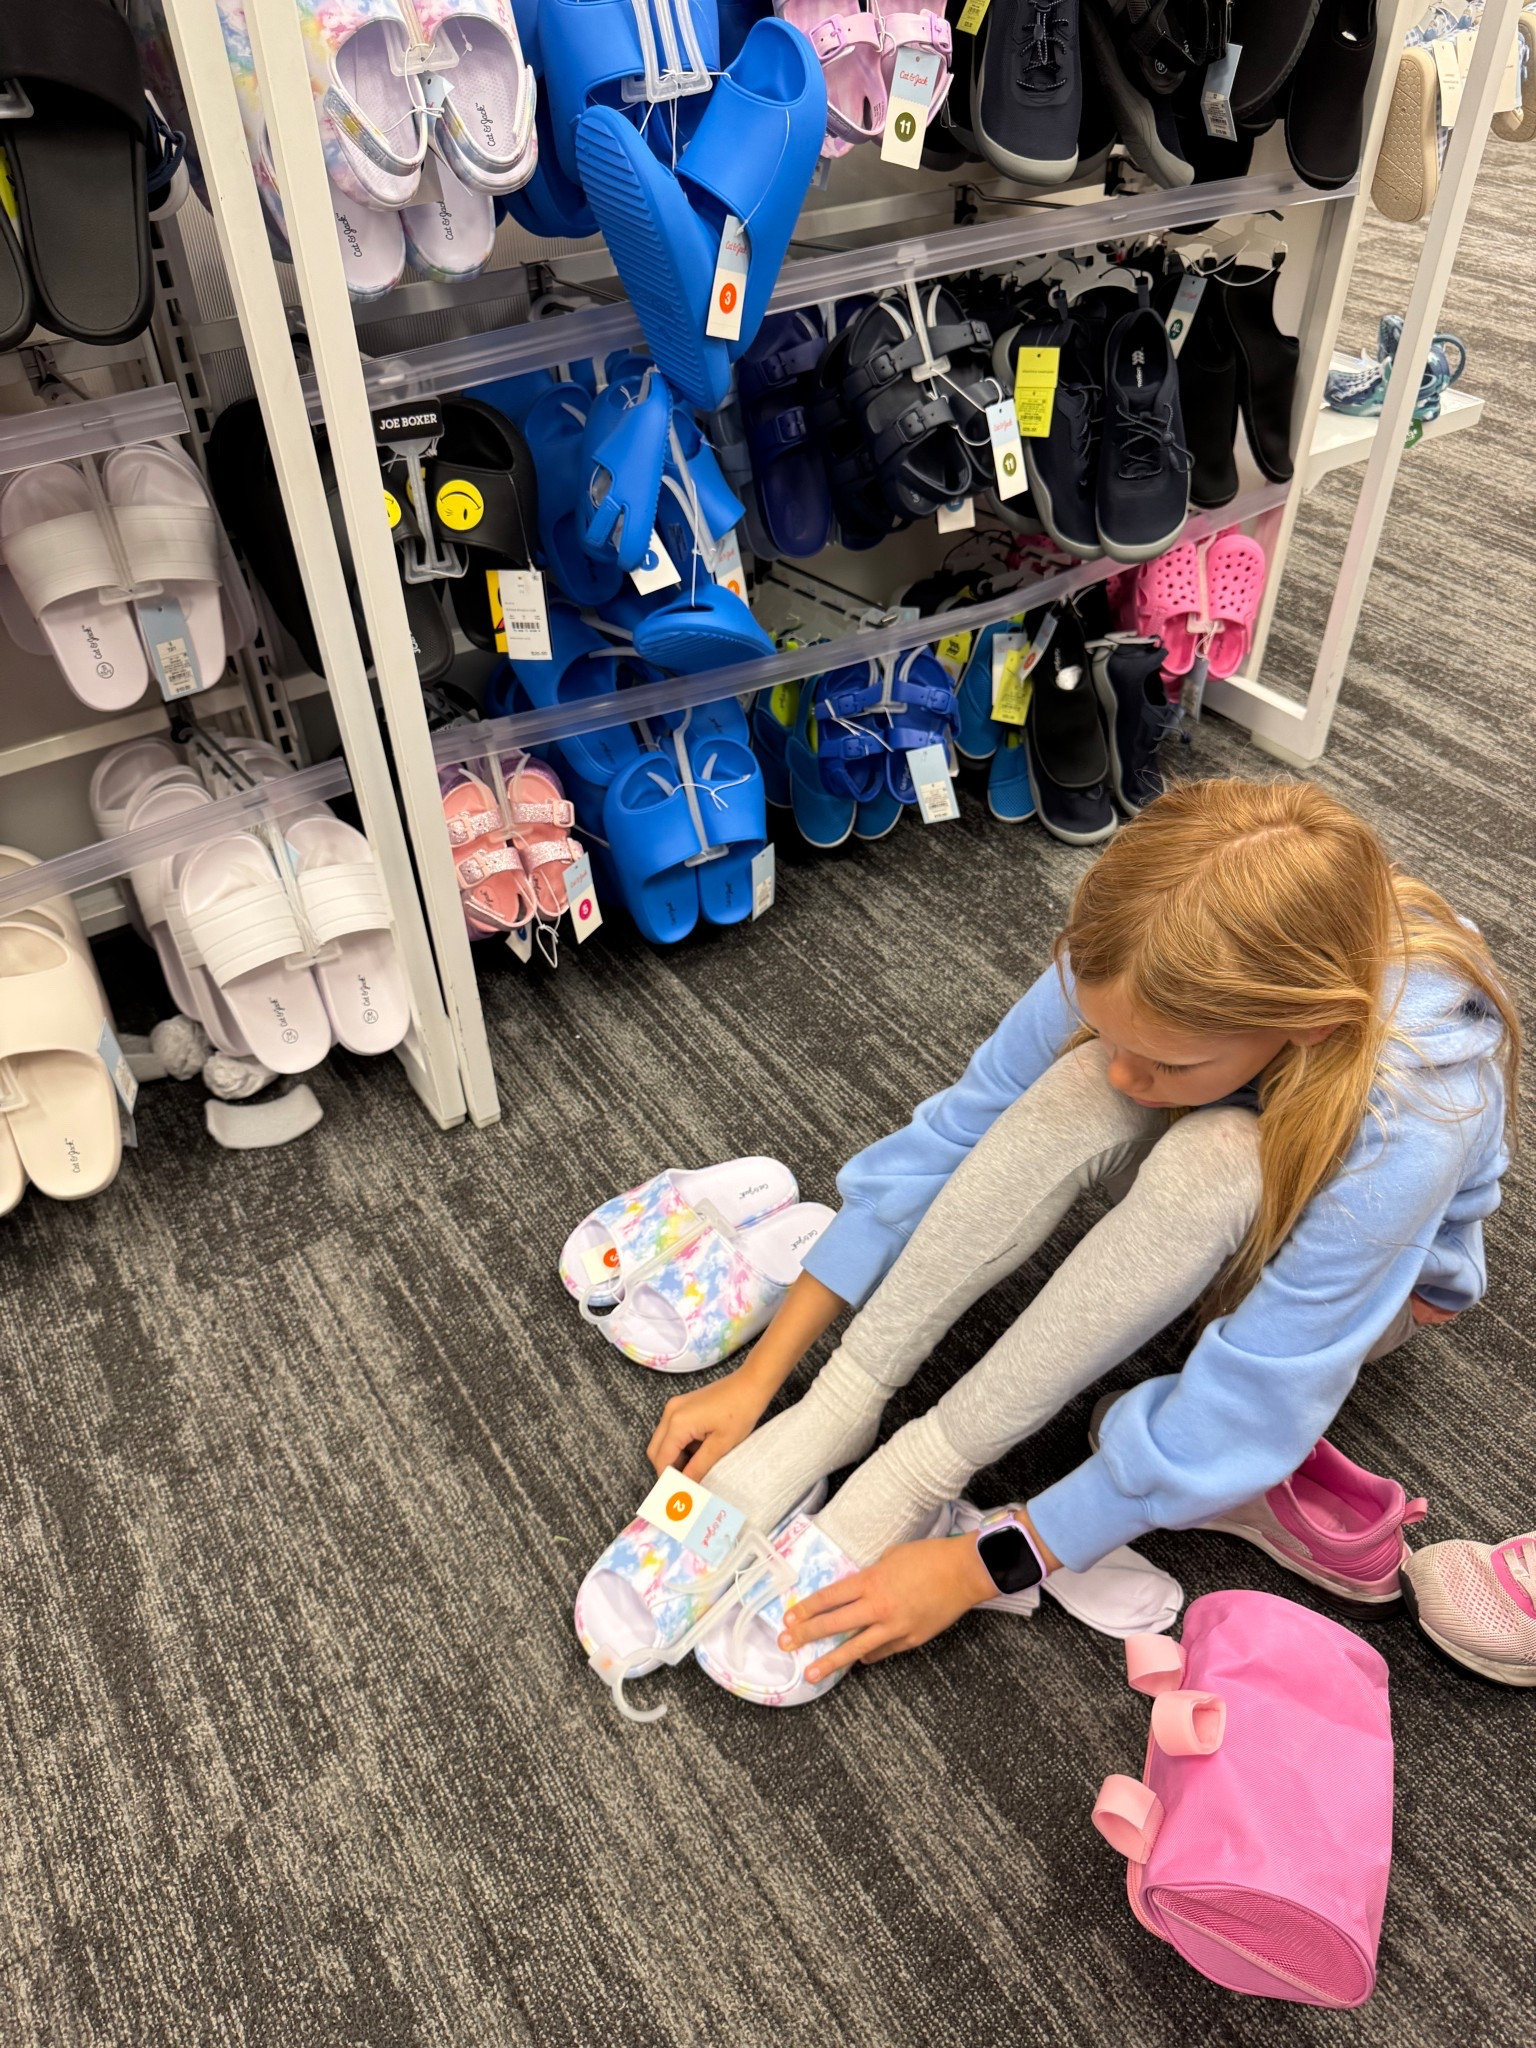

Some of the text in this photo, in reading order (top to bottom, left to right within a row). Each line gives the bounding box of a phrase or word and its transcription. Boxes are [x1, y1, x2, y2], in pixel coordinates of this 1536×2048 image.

[900, 70, 909, 80] Cat
[914, 74, 928, 86] Jack
[476, 104, 494, 124] Jack
[900, 119, 911, 135] 11
[486, 133, 496, 147] Cat
[338, 214, 358, 234] Jack
[445, 226, 454, 240] Cat
[350, 243, 363, 257] Cat
[724, 291, 732, 305] 3
[379, 413, 438, 431] JOE BOXER
[1004, 457, 1014, 471] 11
[93, 648, 103, 660] Cat
[72, 1162, 80, 1173] Cat
[673, 1499, 686, 1513] 2
[715, 1509, 727, 1523] Cat
[702, 1525, 717, 1548] Jack
